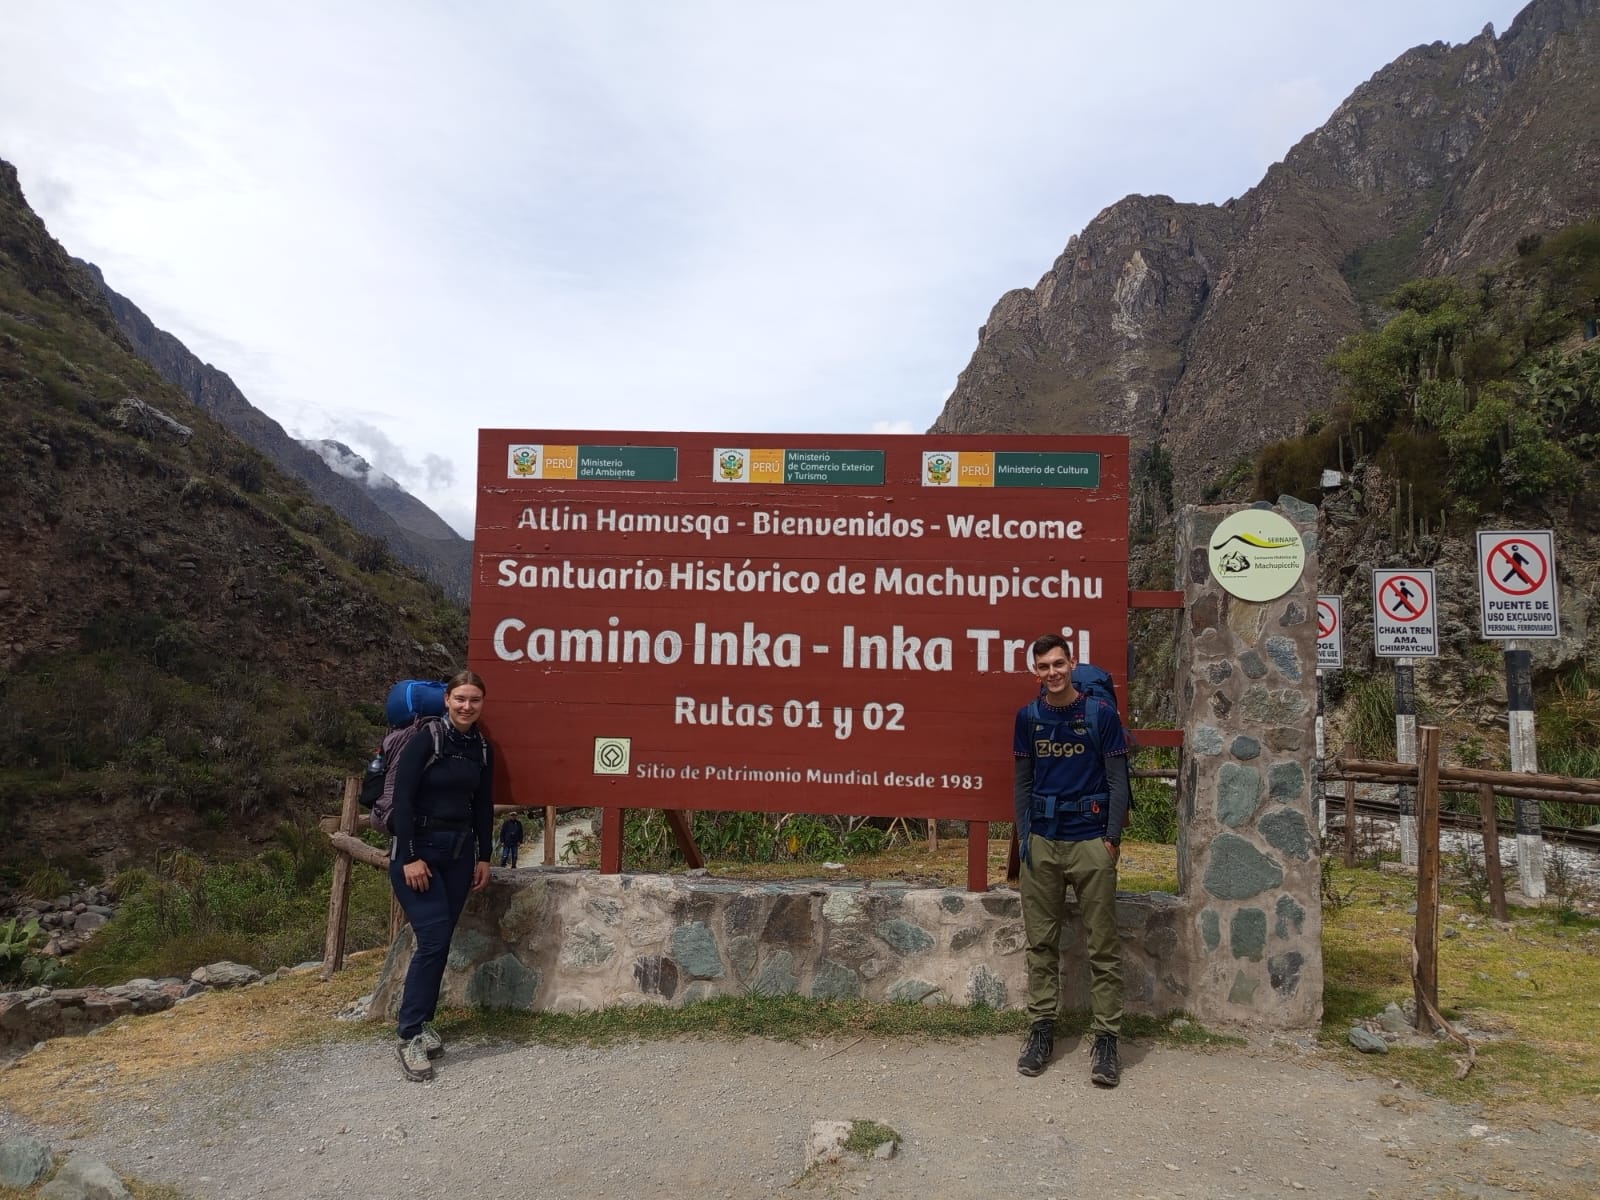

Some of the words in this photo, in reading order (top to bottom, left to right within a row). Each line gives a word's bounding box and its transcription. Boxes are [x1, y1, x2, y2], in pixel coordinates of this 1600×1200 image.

[788, 452, 830, 462] Ministerio
[545, 456, 573, 469] PERÚ
[580, 457, 623, 468] Ministerio
[752, 460, 780, 473] PERÚ
[787, 462, 799, 471] de
[800, 462, 839, 472] Comercio
[841, 463, 875, 472] Exterior
[580, 467, 594, 476] del
[595, 468, 636, 477] Ambiente
[961, 463, 990, 476] PERÚ
[998, 464, 1042, 474] Ministerio
[1043, 465, 1055, 474] de
[1057, 465, 1089, 475] Cultura
[787, 472, 793, 481] y
[795, 472, 828, 481] Turismo
[518, 506, 588, 531] Allin
[596, 508, 730, 540] Hamusqa
[753, 510, 925, 538] Bienvenidos
[946, 513, 1083, 540] Welcome
[1254, 561, 1299, 570] Machupicchu
[497, 559, 664, 591] Santuario
[669, 559, 821, 594] Histórico
[826, 565, 866, 595] de
[874, 566, 1103, 605] Machupicchu
[1489, 601, 1532, 610] PUENTE
[1535, 601, 1550, 610] DE
[1488, 613, 1505, 622] USO
[1507, 613, 1553, 622] EXCLUSIVO
[1378, 626, 1409, 635] CHAKA
[1410, 627, 1433, 635] TREN
[1488, 624, 1516, 632] PERSONAL
[493, 616, 684, 665] Camino
[693, 621, 801, 668] Inka
[812, 644, 830, 654] -
[842, 624, 953, 672] Inka
[1393, 636, 1418, 644] AMA
[1380, 644, 1433, 652] CHIMPAYCHU
[674, 696, 774, 727] Rutas
[783, 698, 823, 729] 01
[833, 704, 854, 741] y
[862, 702, 906, 732] 02
[1035, 738, 1085, 759] Ziggo
[636, 763, 676, 779] Sitio
[680, 764, 700, 780] de
[705, 766, 801, 784] Patrimonio
[806, 768, 878, 787] Mundial
[883, 771, 935, 789] desde
[940, 774, 984, 791] 1983
